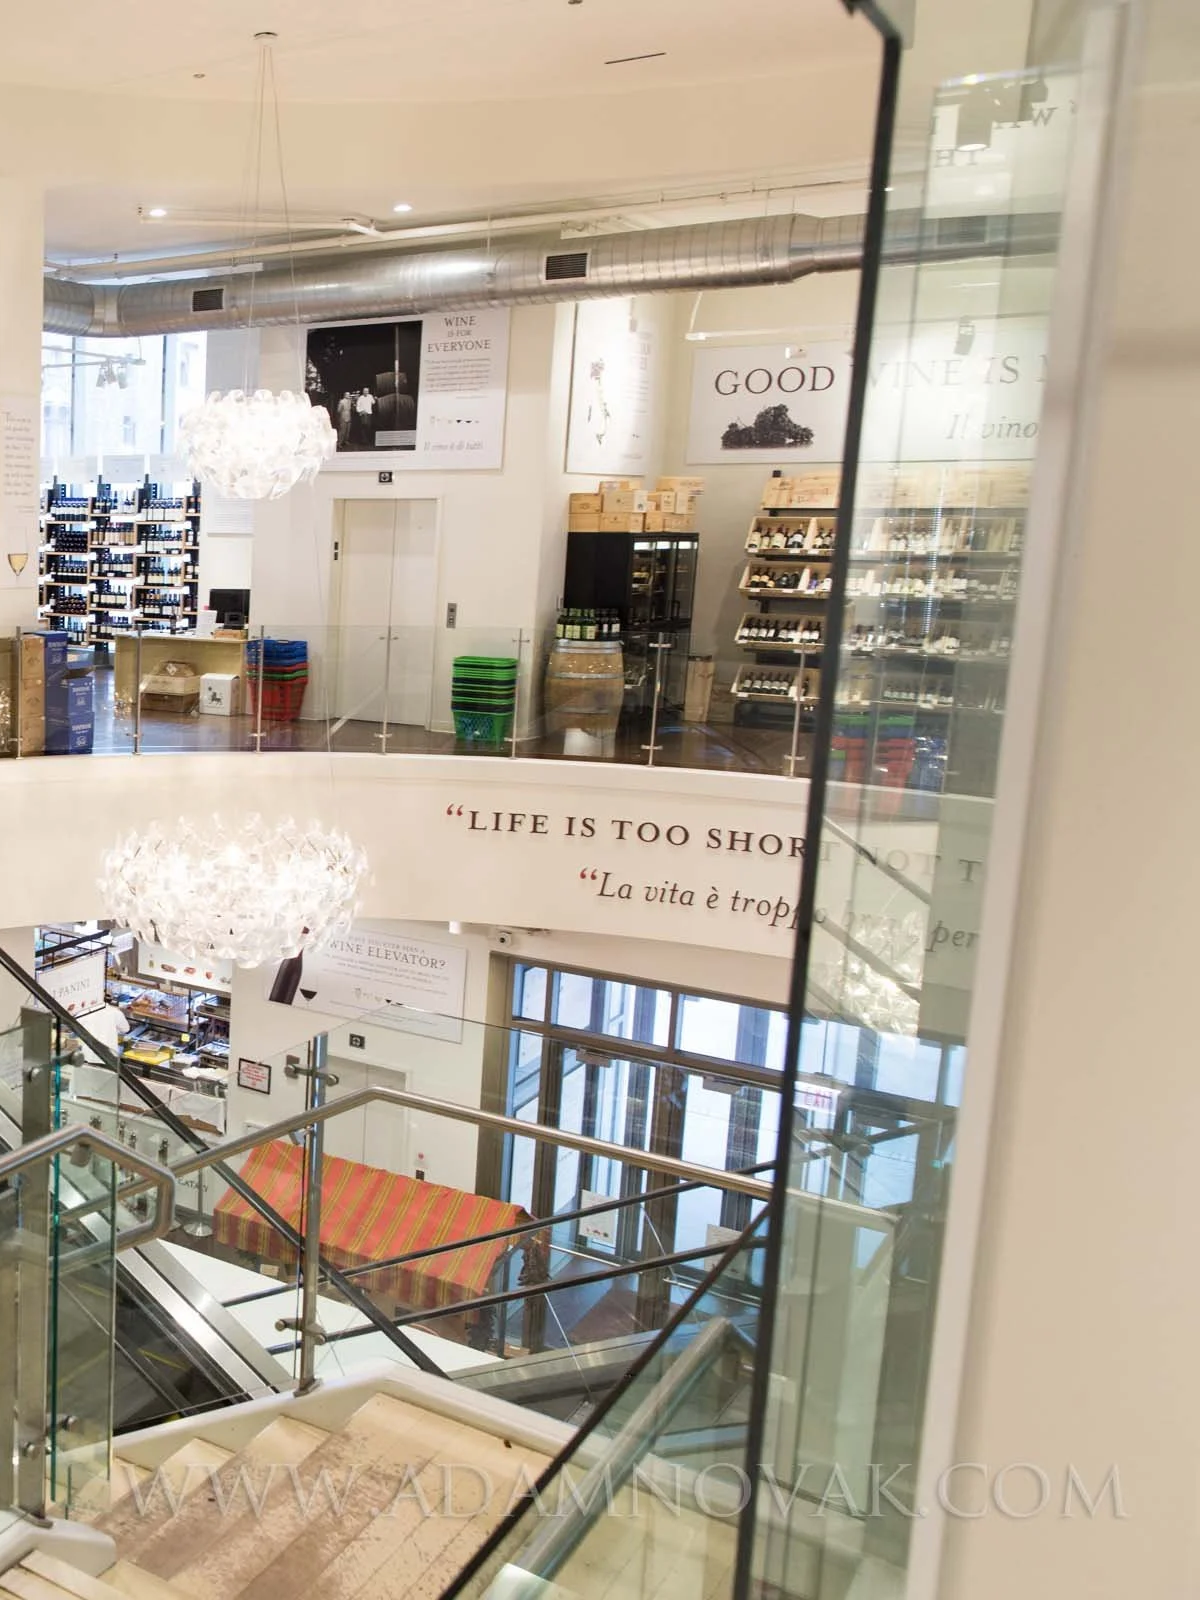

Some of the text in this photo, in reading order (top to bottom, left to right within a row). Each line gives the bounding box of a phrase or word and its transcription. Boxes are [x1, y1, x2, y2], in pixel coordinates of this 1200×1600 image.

[444, 316, 477, 326] WINE
[427, 340, 492, 353] EVERYONE
[714, 365, 835, 396] GOOD
[983, 355, 1019, 385] IS
[981, 416, 1040, 440] vino
[564, 816, 596, 838] IS
[611, 819, 689, 846] TOO
[644, 882, 695, 907] vita
[706, 883, 719, 909] è
[925, 920, 989, 952] per
[330, 939, 362, 954] WINE
[367, 945, 445, 969] ELEVATOR?
[59, 978, 90, 998] PANINI
